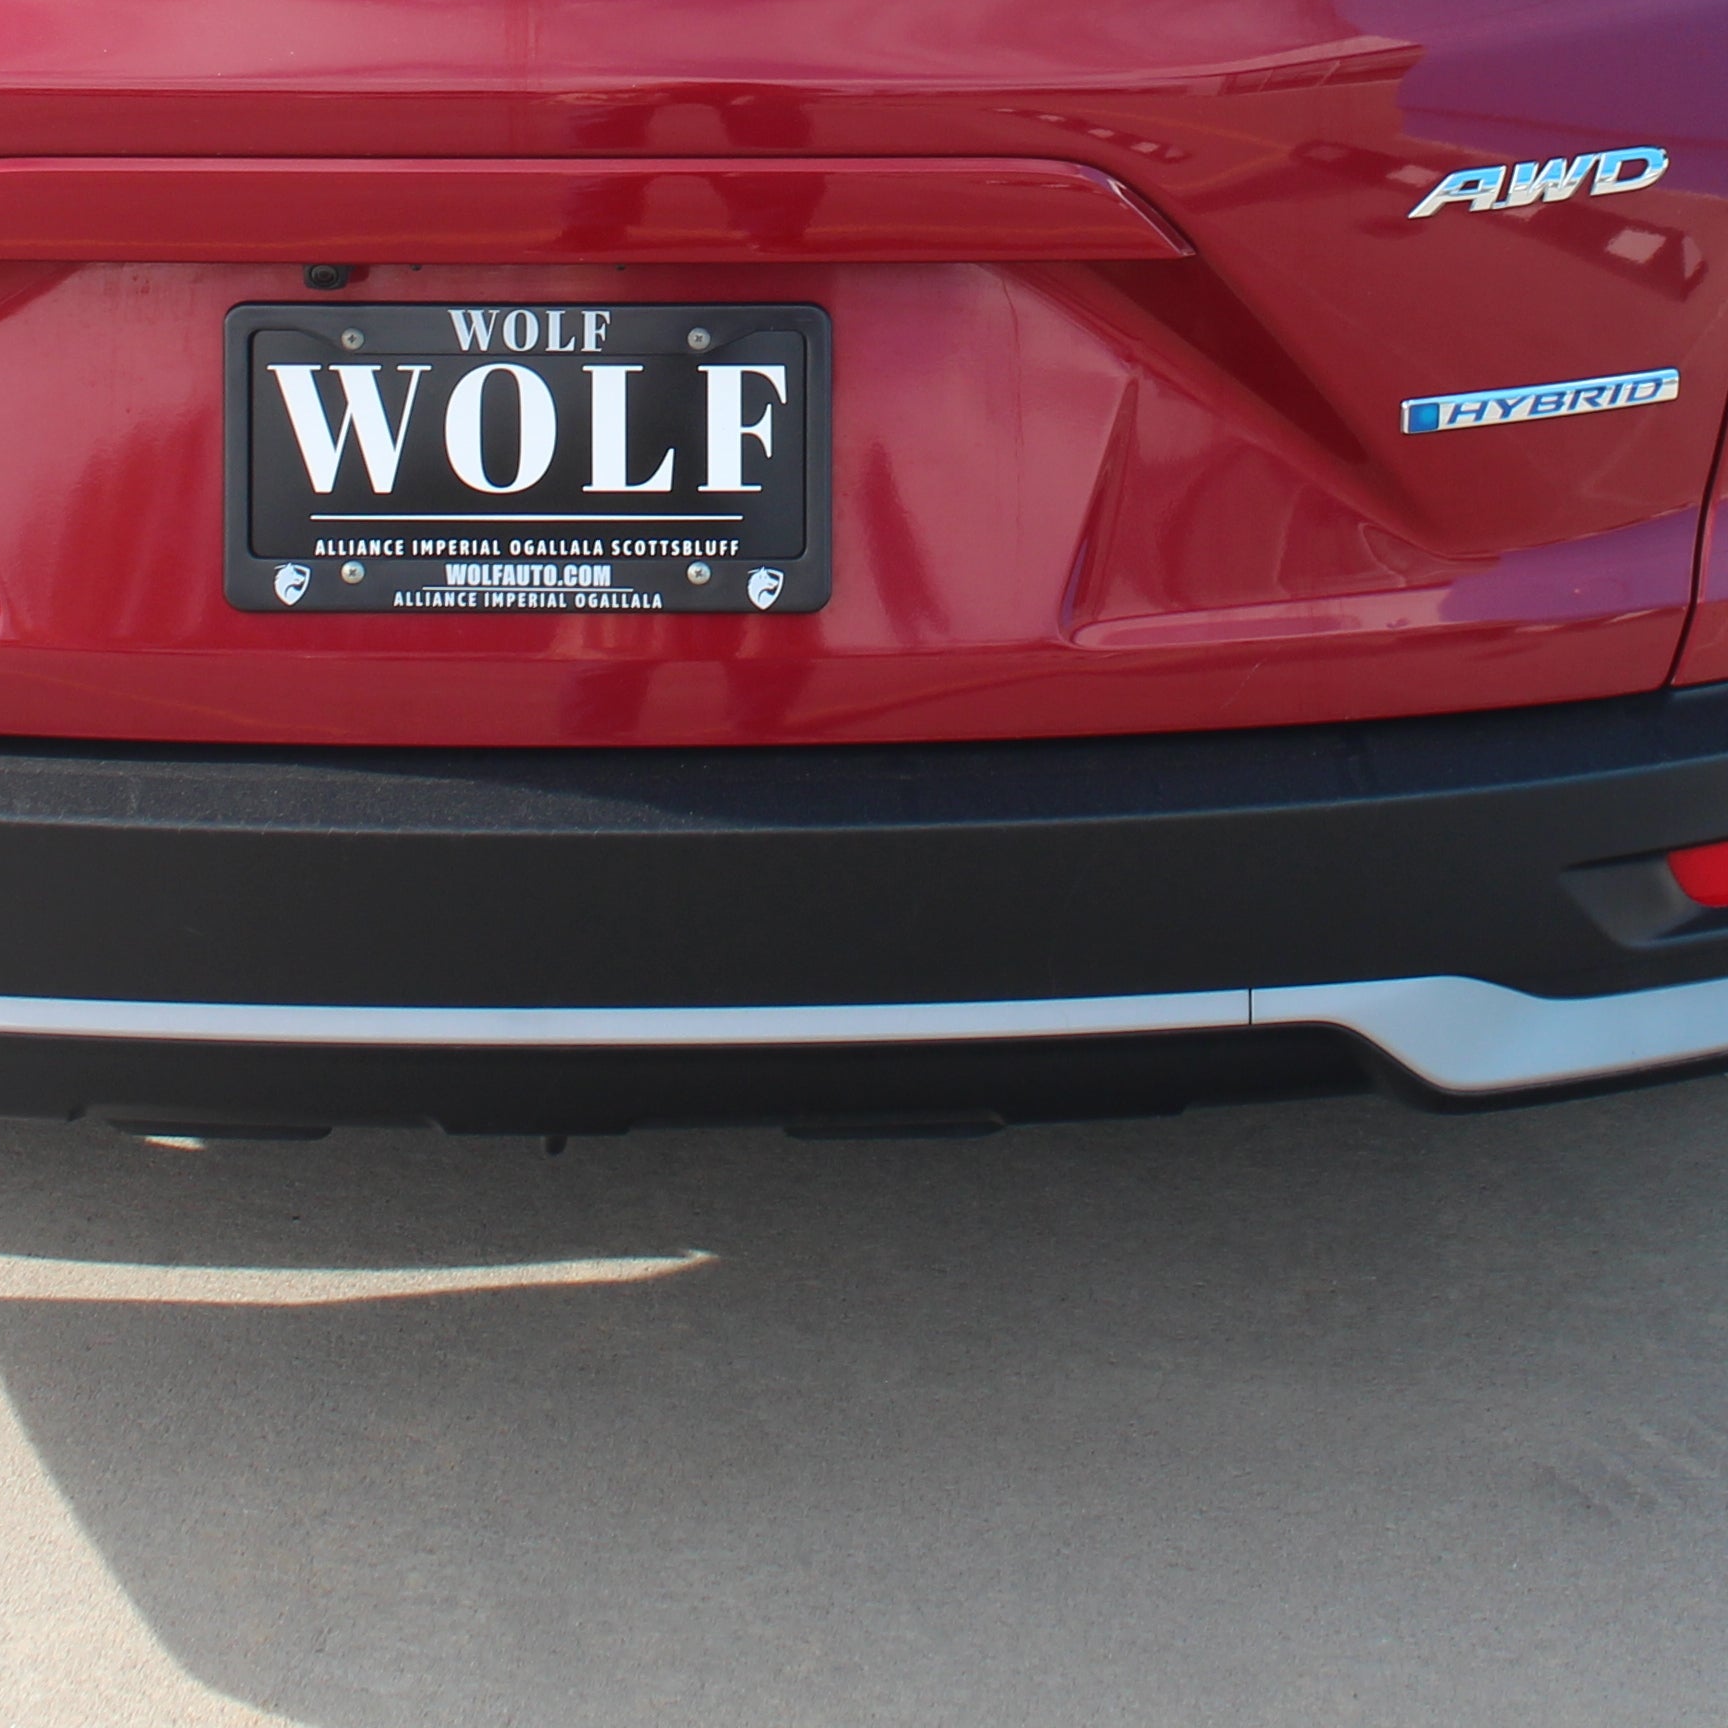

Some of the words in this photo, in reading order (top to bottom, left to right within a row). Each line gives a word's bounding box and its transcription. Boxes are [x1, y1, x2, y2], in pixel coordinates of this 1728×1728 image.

[1407, 145, 1671, 219] AWD
[447, 308, 612, 353] WOLF
[1445, 376, 1665, 426] HYBRID
[267, 362, 788, 495] WOLF
[314, 539, 405, 556] ALLIANCE
[412, 539, 501, 556] IMPERIAL
[509, 539, 604, 556] OGALLALA
[610, 539, 740, 556] SCOTTSBLUFF
[444, 563, 612, 587] WOLFAUTO.COM
[393, 591, 478, 607] ALLIANCE
[483, 592, 567, 609] IMPERIAL
[574, 592, 663, 609] OGALLALA
